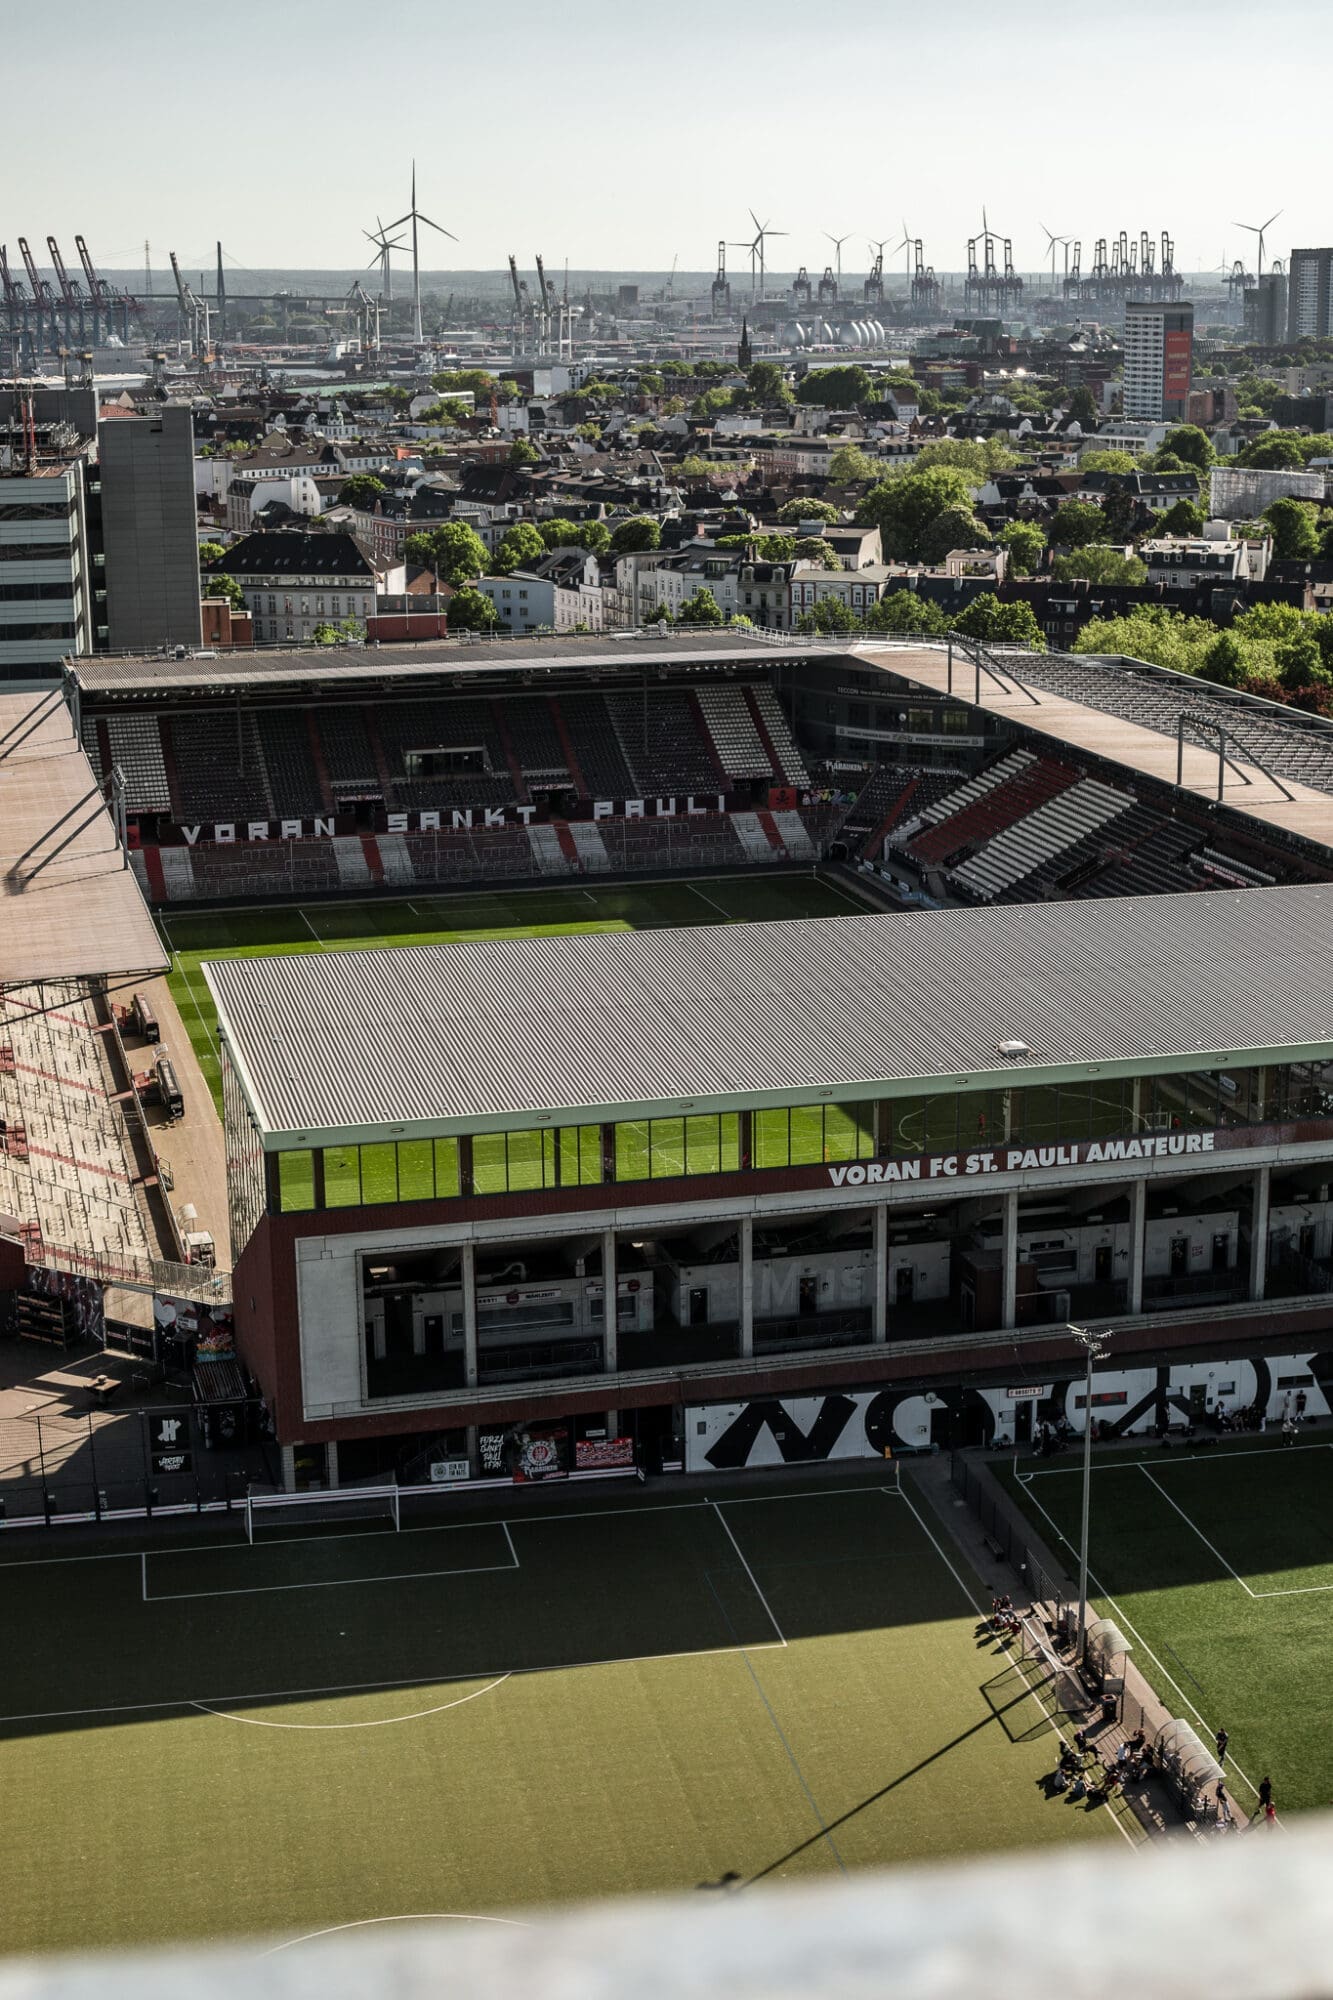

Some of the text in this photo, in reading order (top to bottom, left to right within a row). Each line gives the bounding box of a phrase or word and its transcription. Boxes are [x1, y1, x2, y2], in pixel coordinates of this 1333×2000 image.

[181, 795, 725, 845] VORAN SANKT PAULI
[828, 1132, 1215, 1186] VORAN FC ST. PAULI AMATEURE
